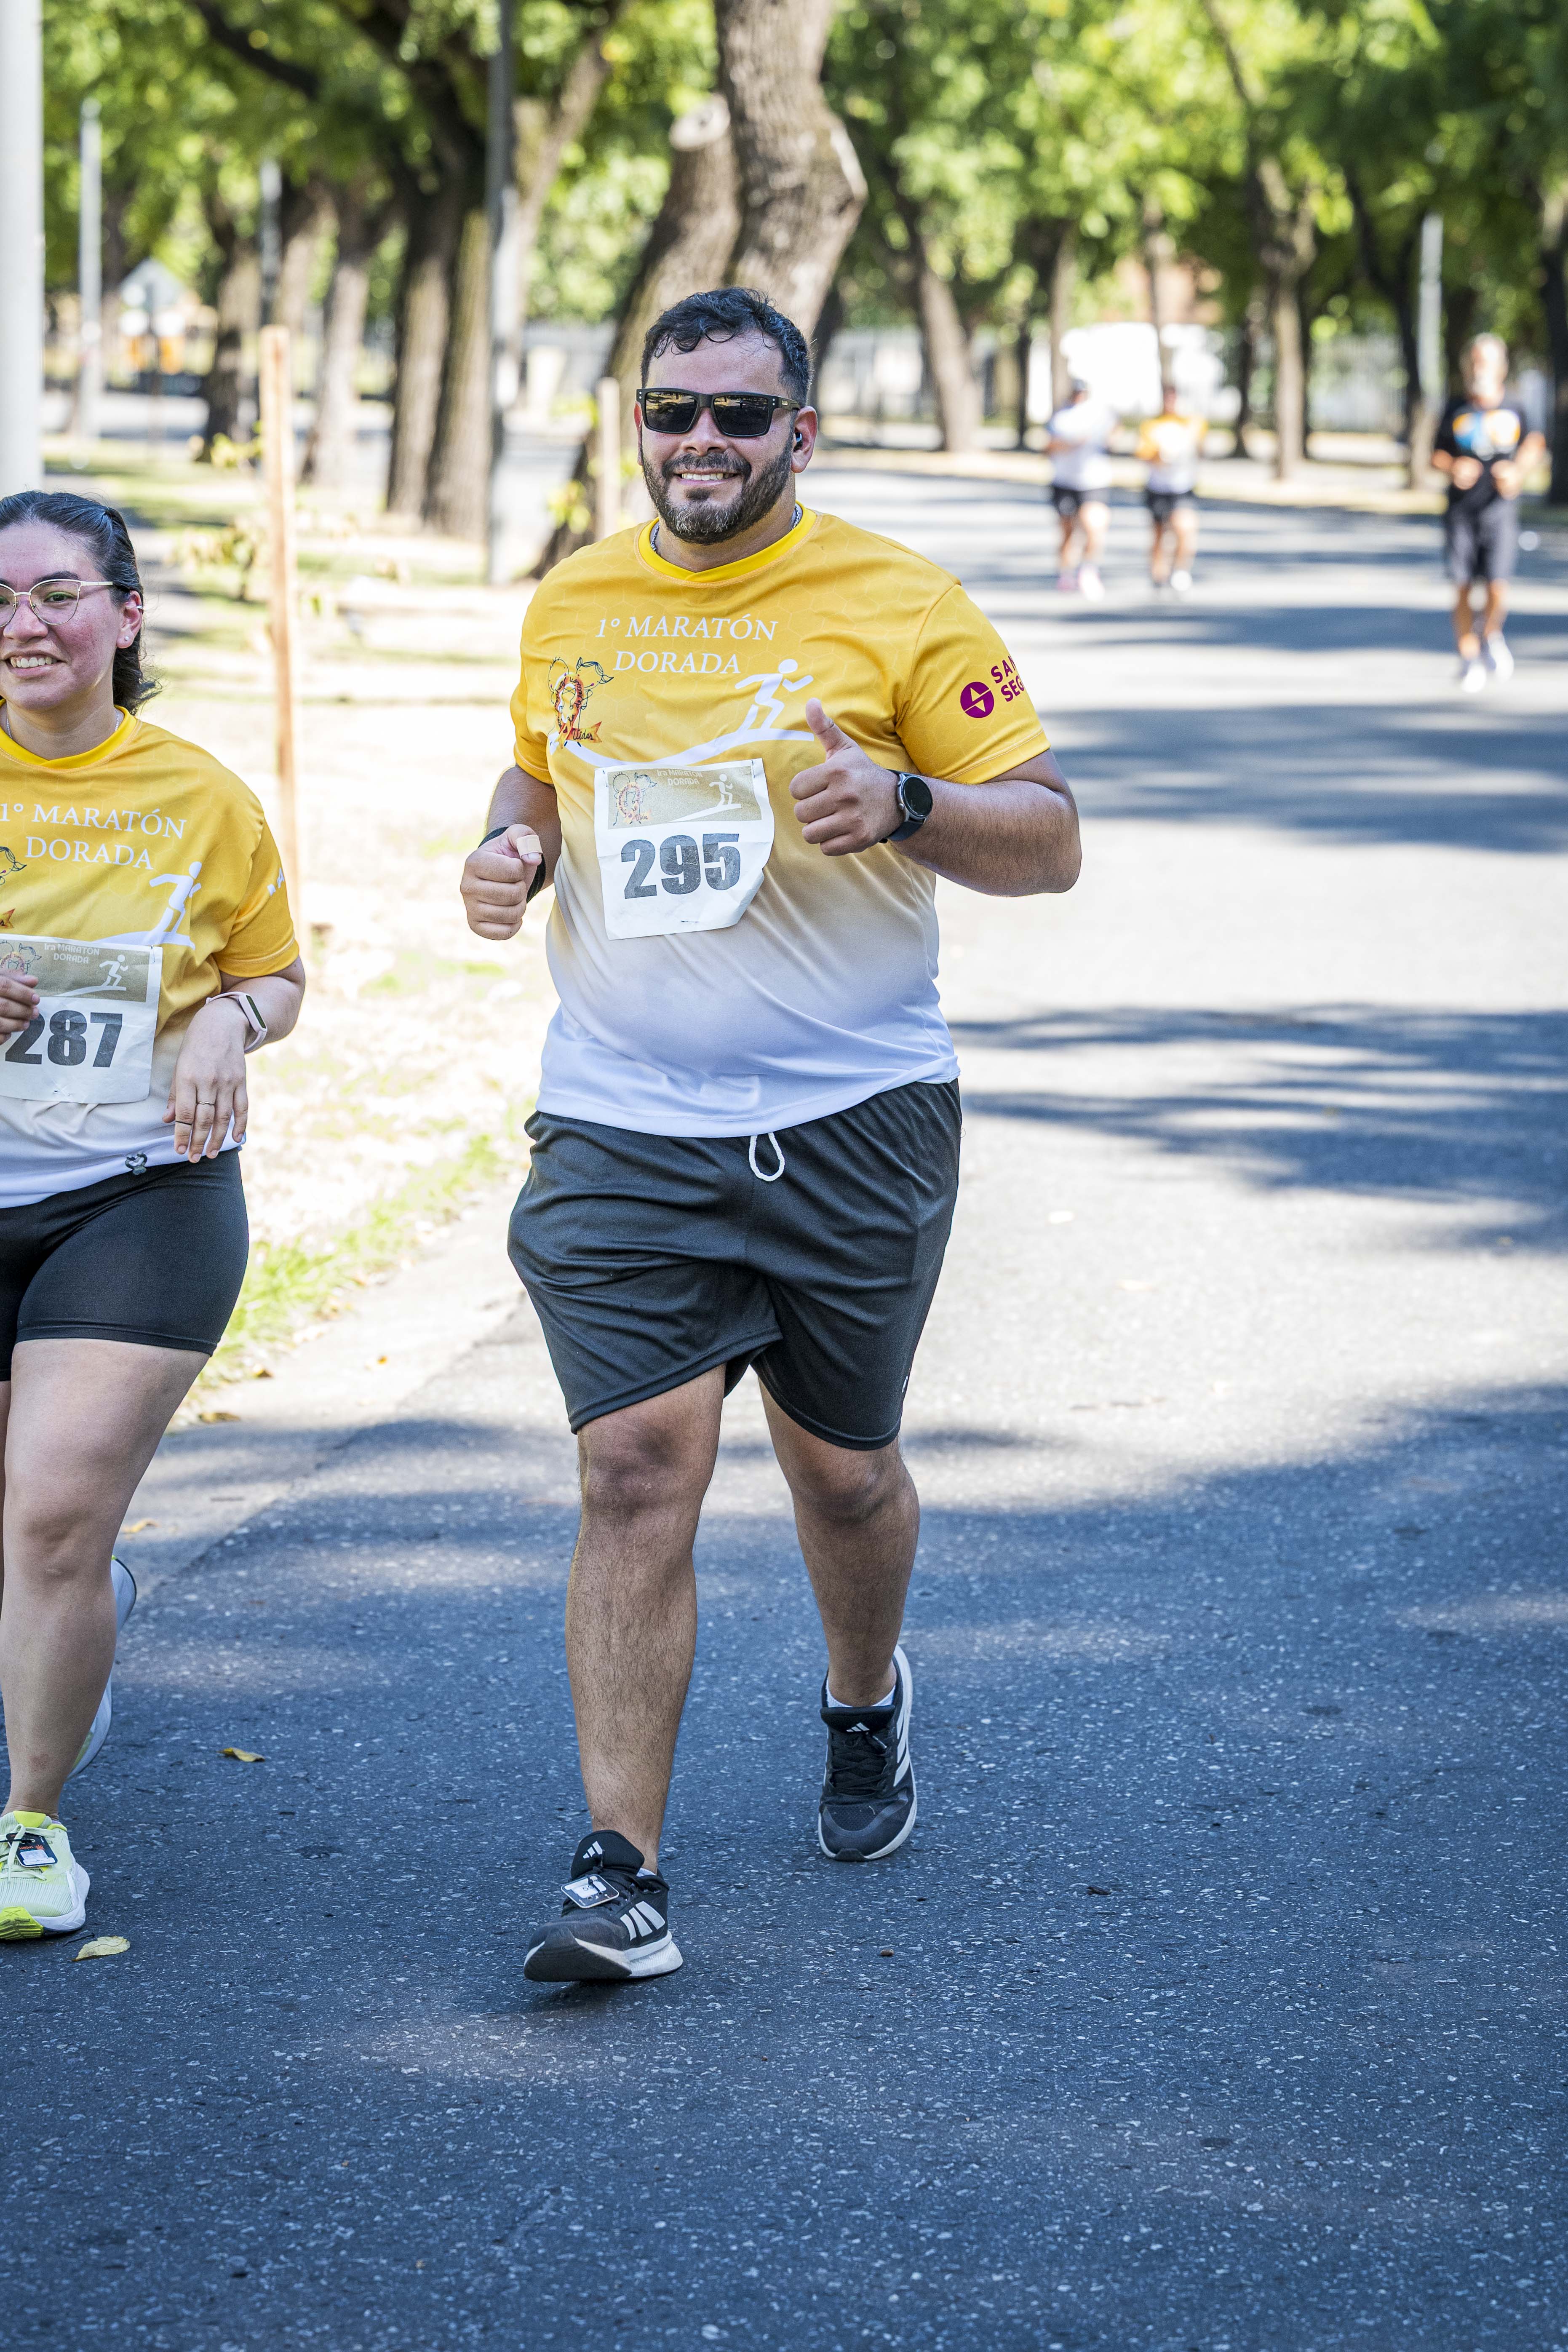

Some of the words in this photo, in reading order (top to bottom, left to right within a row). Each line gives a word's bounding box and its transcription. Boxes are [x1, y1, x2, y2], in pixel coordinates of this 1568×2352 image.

[625, 613, 778, 641] MARATÓN
[613, 651, 740, 674] DORADA
[667, 778, 700, 786] DORADA
[31, 804, 187, 839] MARATÓN
[25, 836, 153, 869] DORADA
[621, 834, 740, 899] 295
[53, 953, 89, 964] DORADA
[5, 1010, 123, 1067] 287
